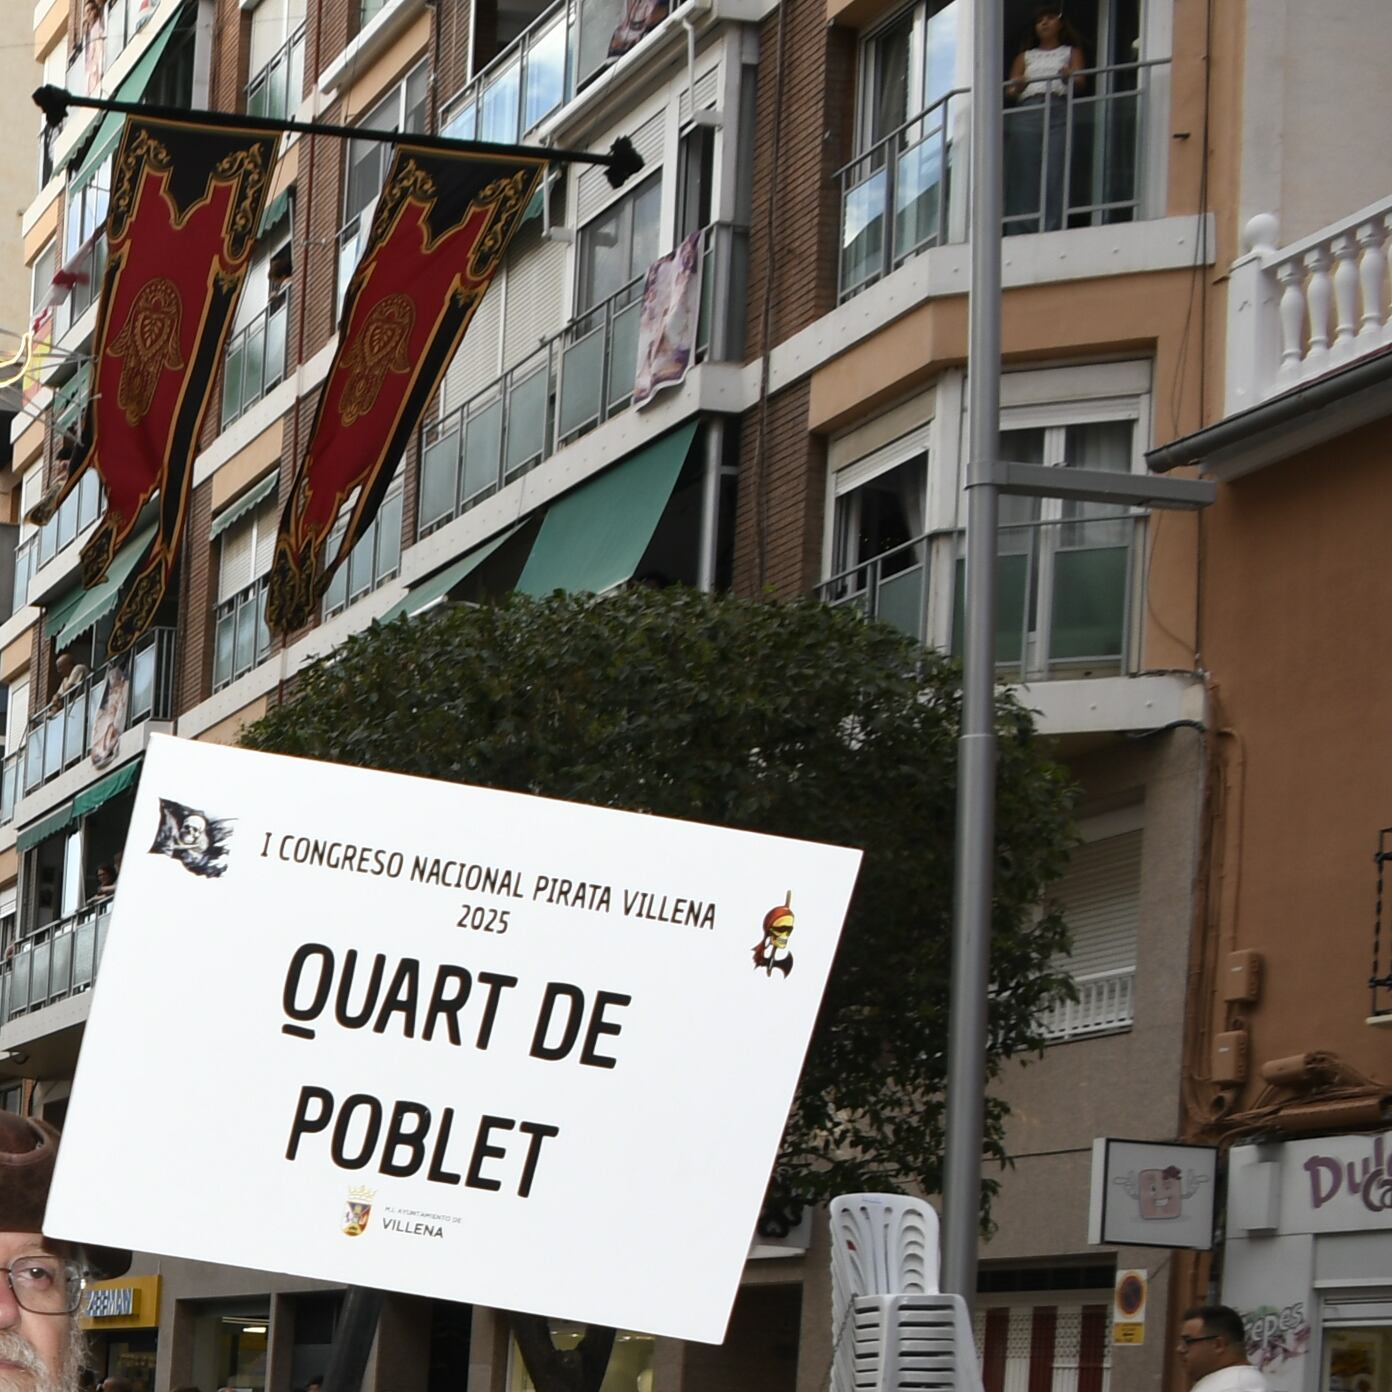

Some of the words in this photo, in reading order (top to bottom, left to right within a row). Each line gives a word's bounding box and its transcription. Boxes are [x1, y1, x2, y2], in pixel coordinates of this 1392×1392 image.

[260, 832, 272, 857] I
[278, 835, 404, 878] CONGRESO
[410, 855, 524, 898] NACIONAL
[532, 875, 612, 913] PIRATA
[622, 889, 716, 930] VILLENA
[457, 904, 510, 934] 2025
[281, 942, 518, 1051] QUART
[529, 982, 632, 1069] DE
[285, 1085, 560, 1198] POBLET
[382, 1217, 445, 1239] VILLENA
[398, 1208, 451, 1223] AYUNTAMIENTO
[452, 1216, 463, 1224] DE
